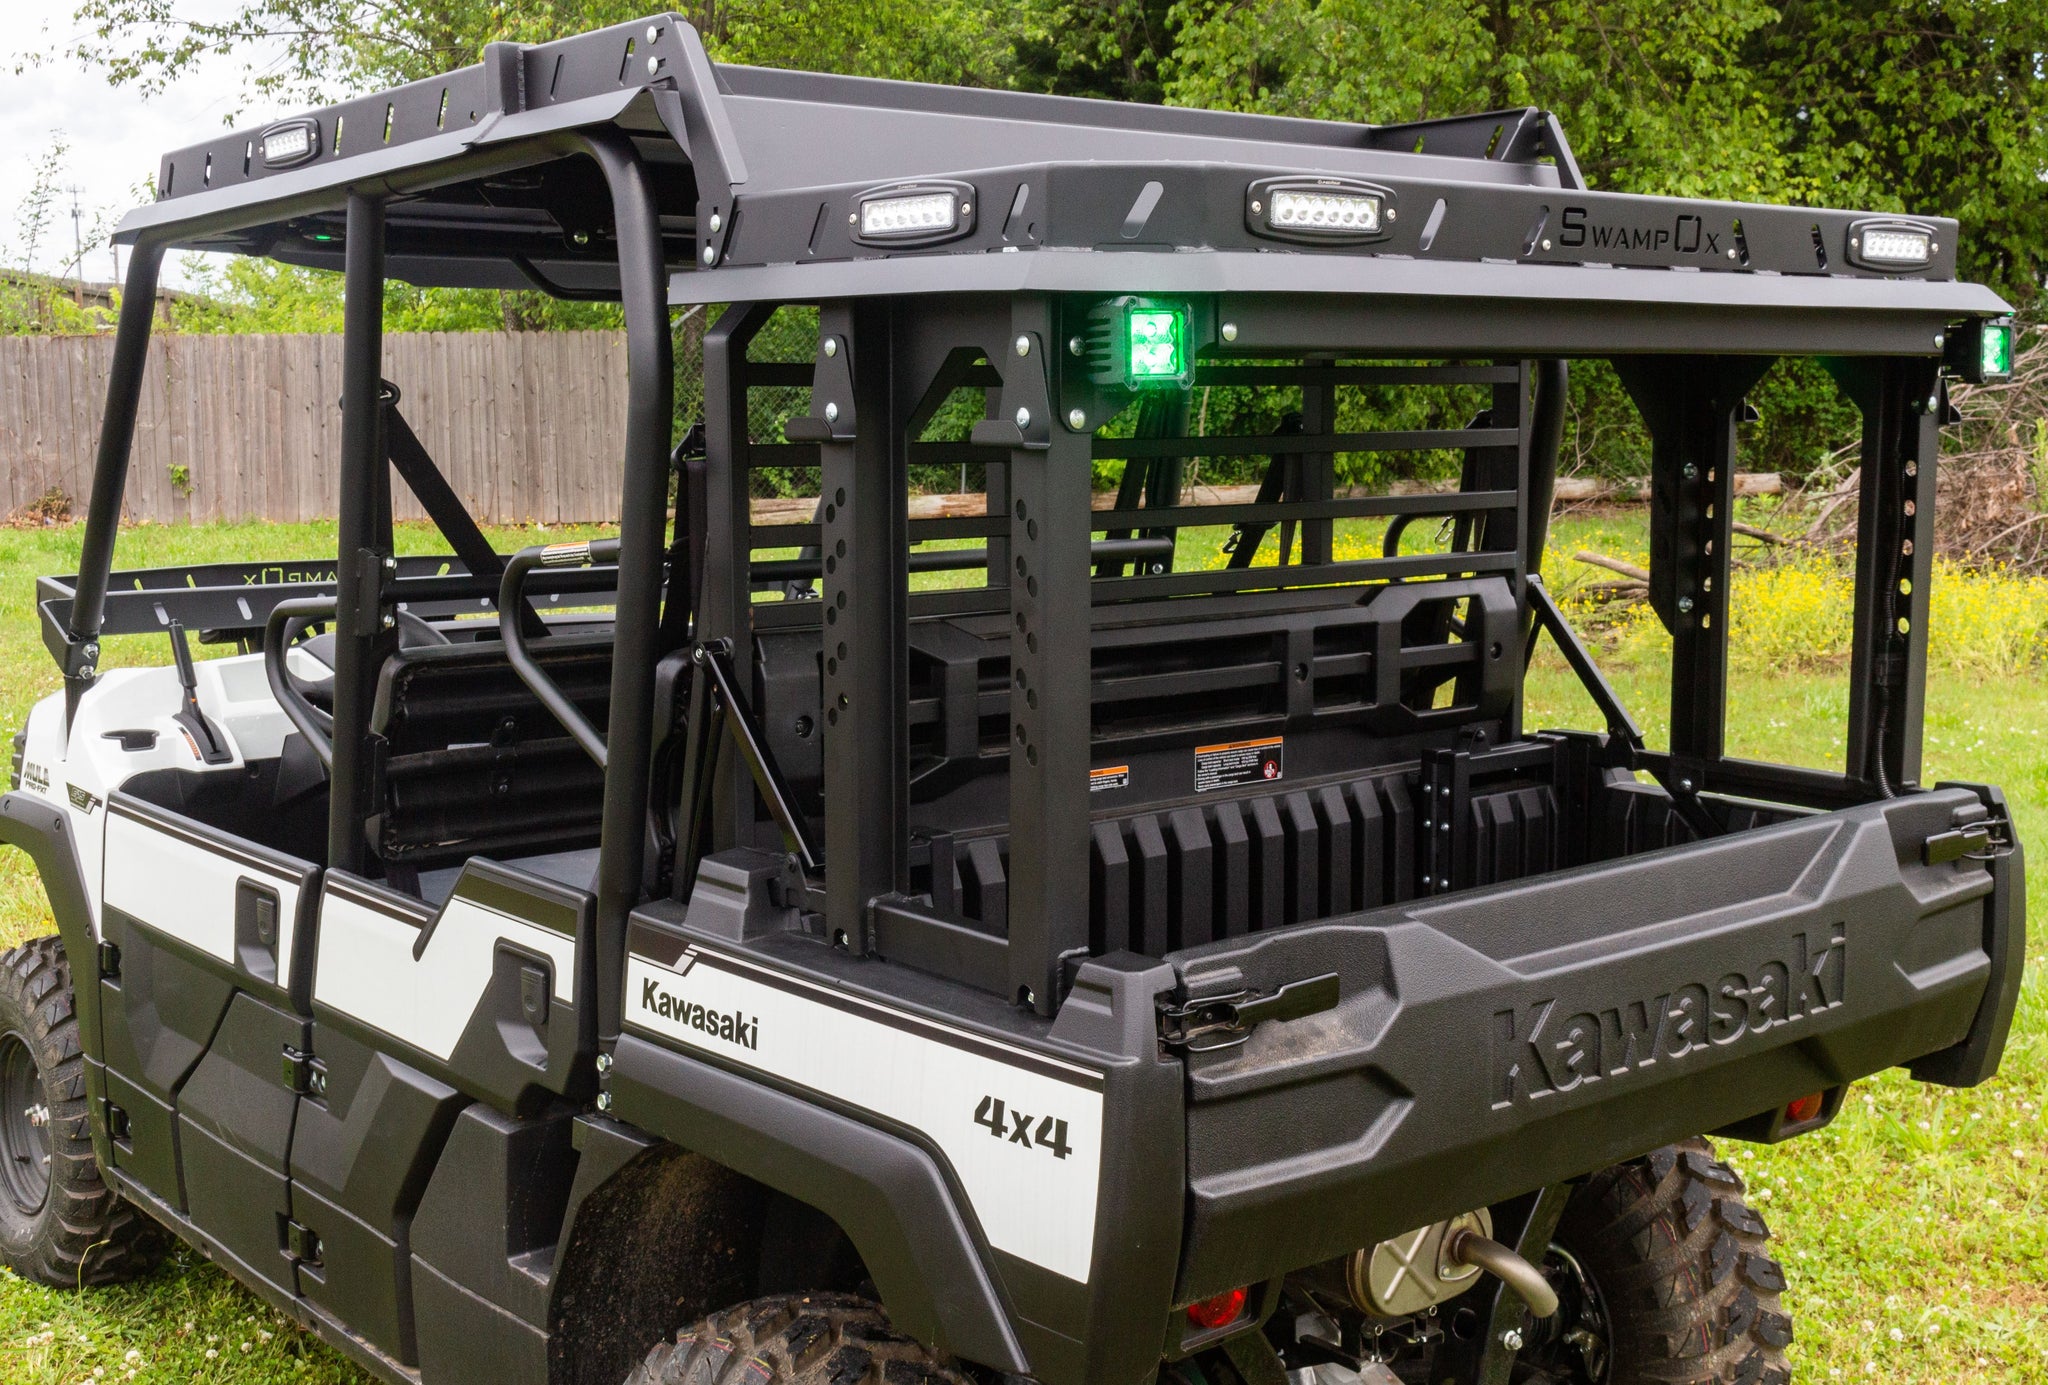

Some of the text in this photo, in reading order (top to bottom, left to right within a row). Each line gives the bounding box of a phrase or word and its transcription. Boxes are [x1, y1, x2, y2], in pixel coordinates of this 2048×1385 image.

[642, 976, 759, 1051] Kawasaki
[1491, 921, 1847, 1111] Kawasaki
[973, 1095, 1073, 1160] 4x4
